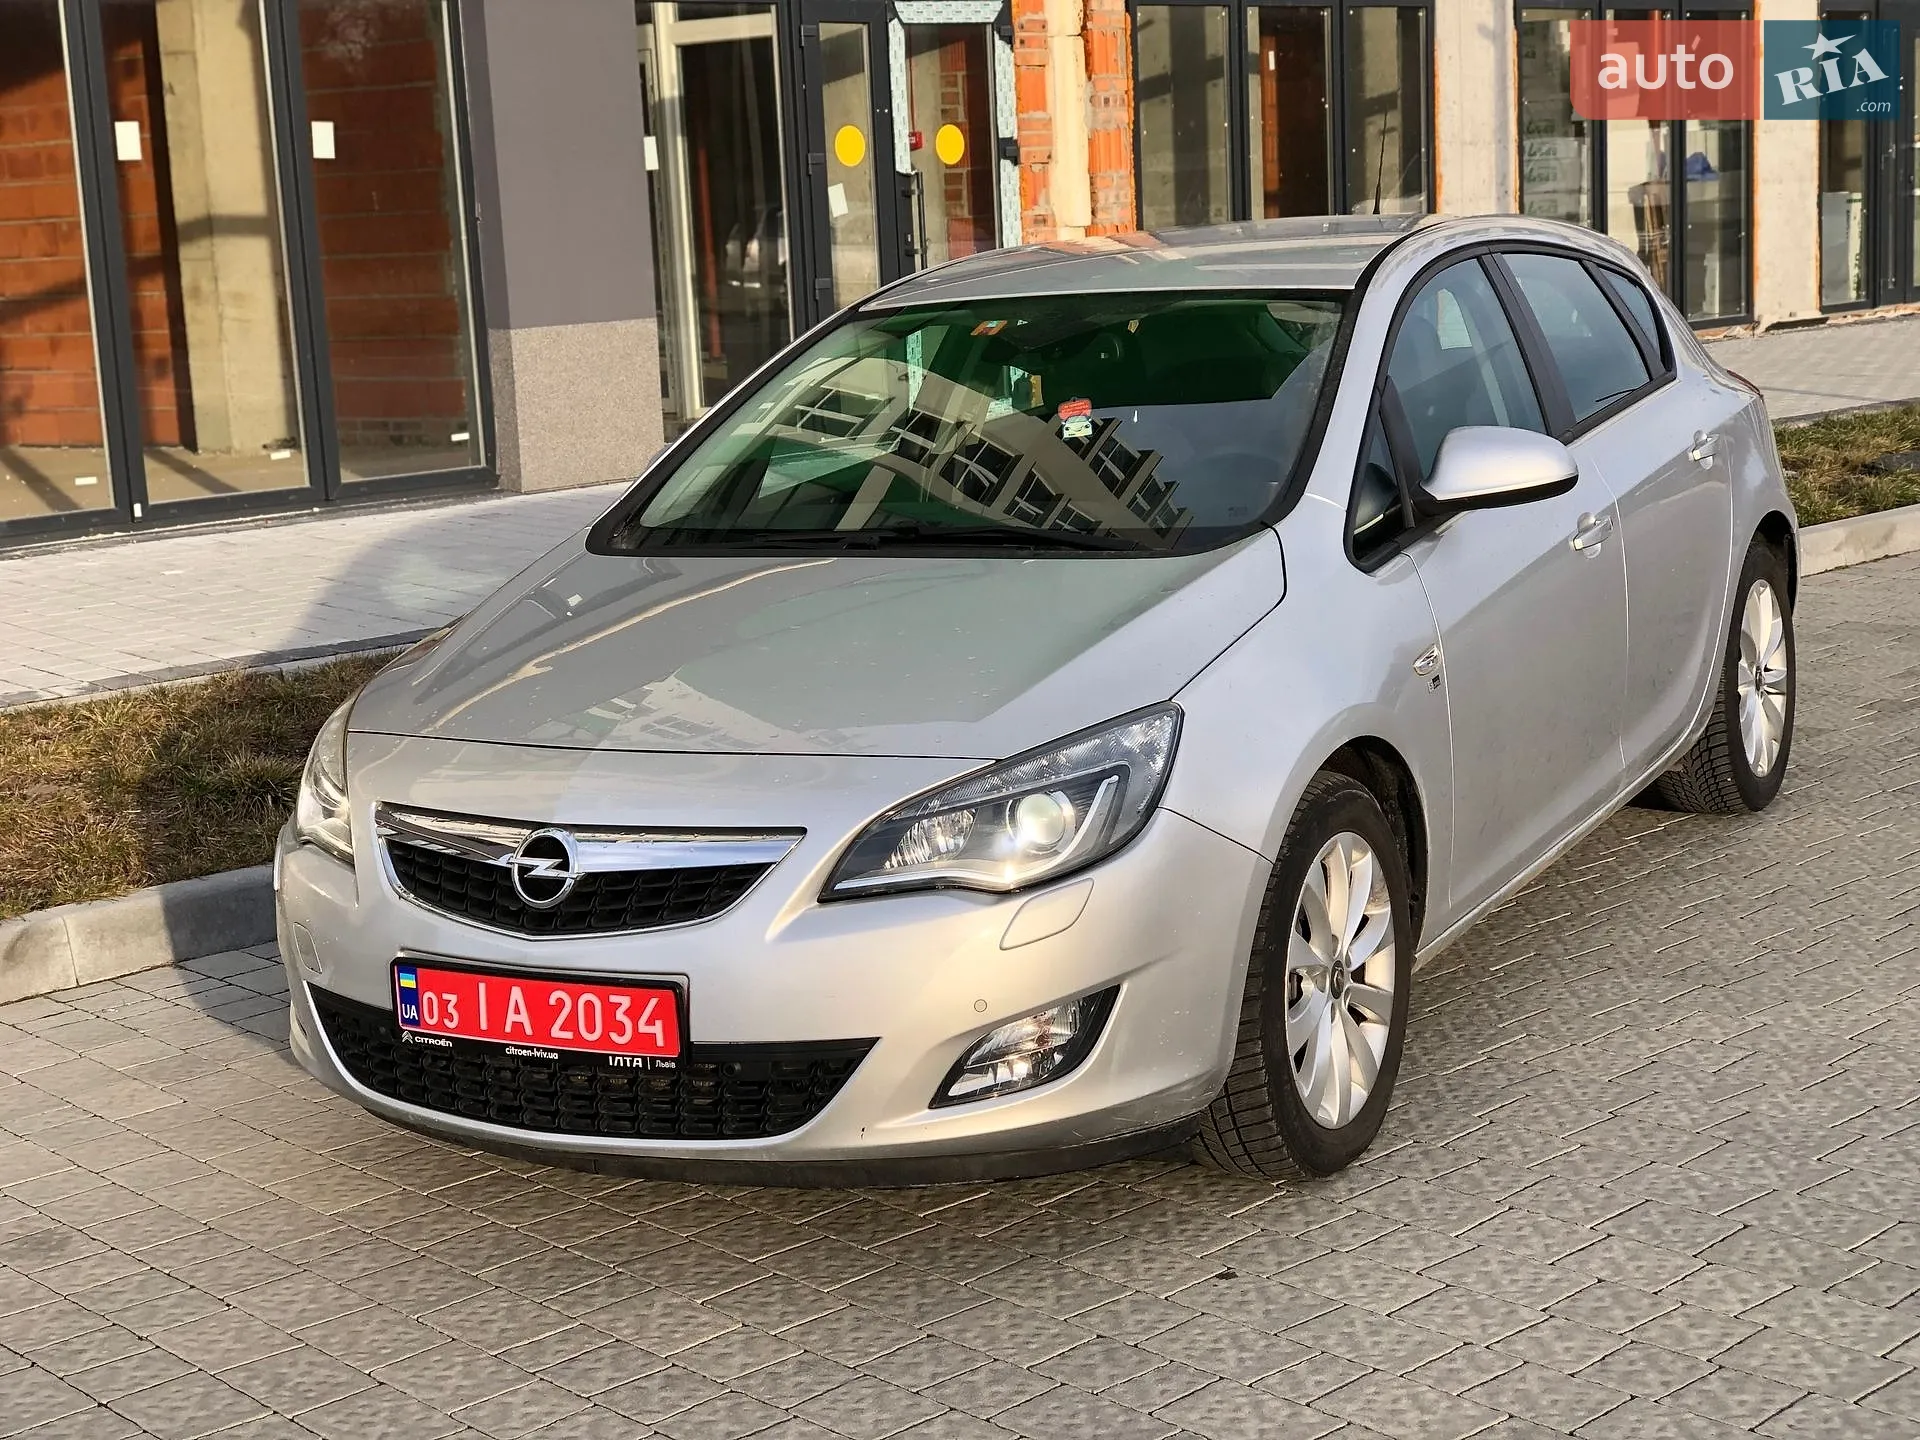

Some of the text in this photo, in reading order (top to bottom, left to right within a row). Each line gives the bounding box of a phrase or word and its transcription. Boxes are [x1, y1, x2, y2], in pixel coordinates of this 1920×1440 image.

[402, 1003, 418, 1021] UA
[422, 991, 459, 1030] 03
[548, 989, 664, 1047] 2034
[505, 1046, 559, 1060] citroen-lviv.ua
